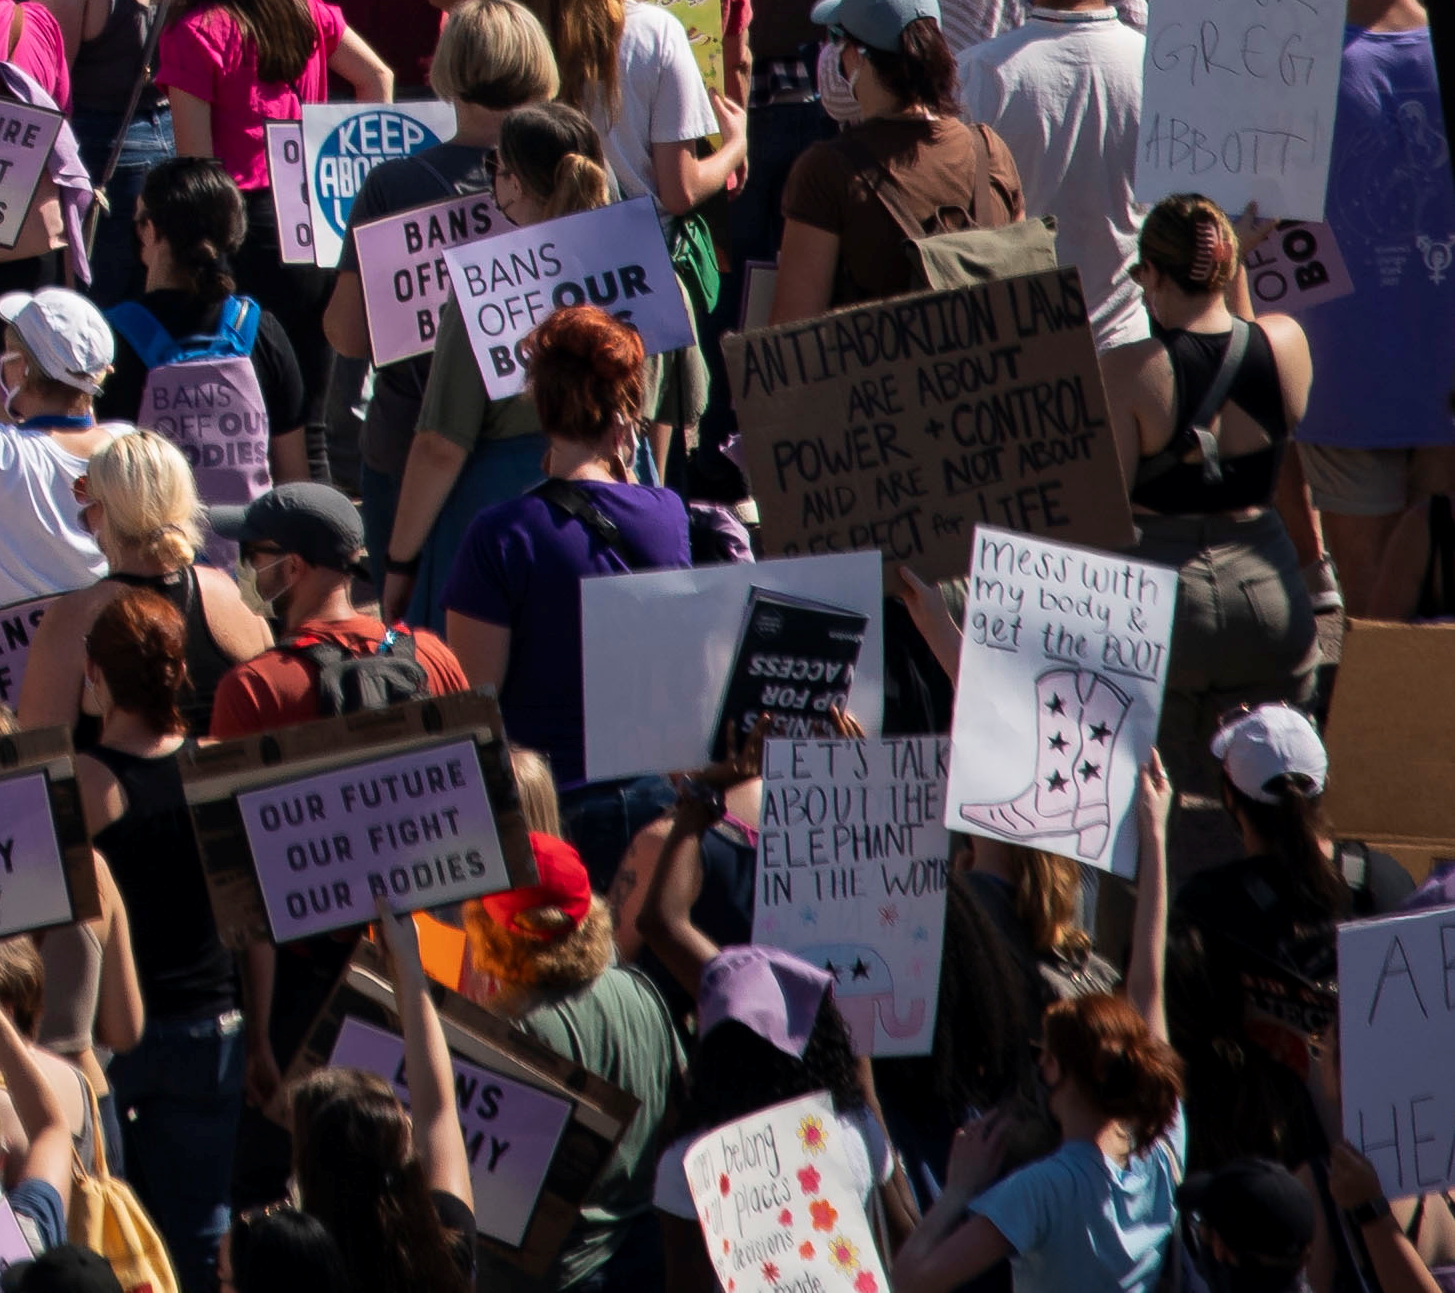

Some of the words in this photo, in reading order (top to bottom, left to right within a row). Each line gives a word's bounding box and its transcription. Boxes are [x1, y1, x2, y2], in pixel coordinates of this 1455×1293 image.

[1149, 22, 1315, 89] GREG
[980, 539, 1073, 585] mess
[1080, 562, 1159, 604] with
[974, 577, 1024, 613] my
[1041, 588, 1110, 631] body
[1127, 607, 1148, 633] &
[972, 614, 1022, 647] get
[1044, 621, 1088, 658] the
[1101, 636, 1166, 676] BOOT
